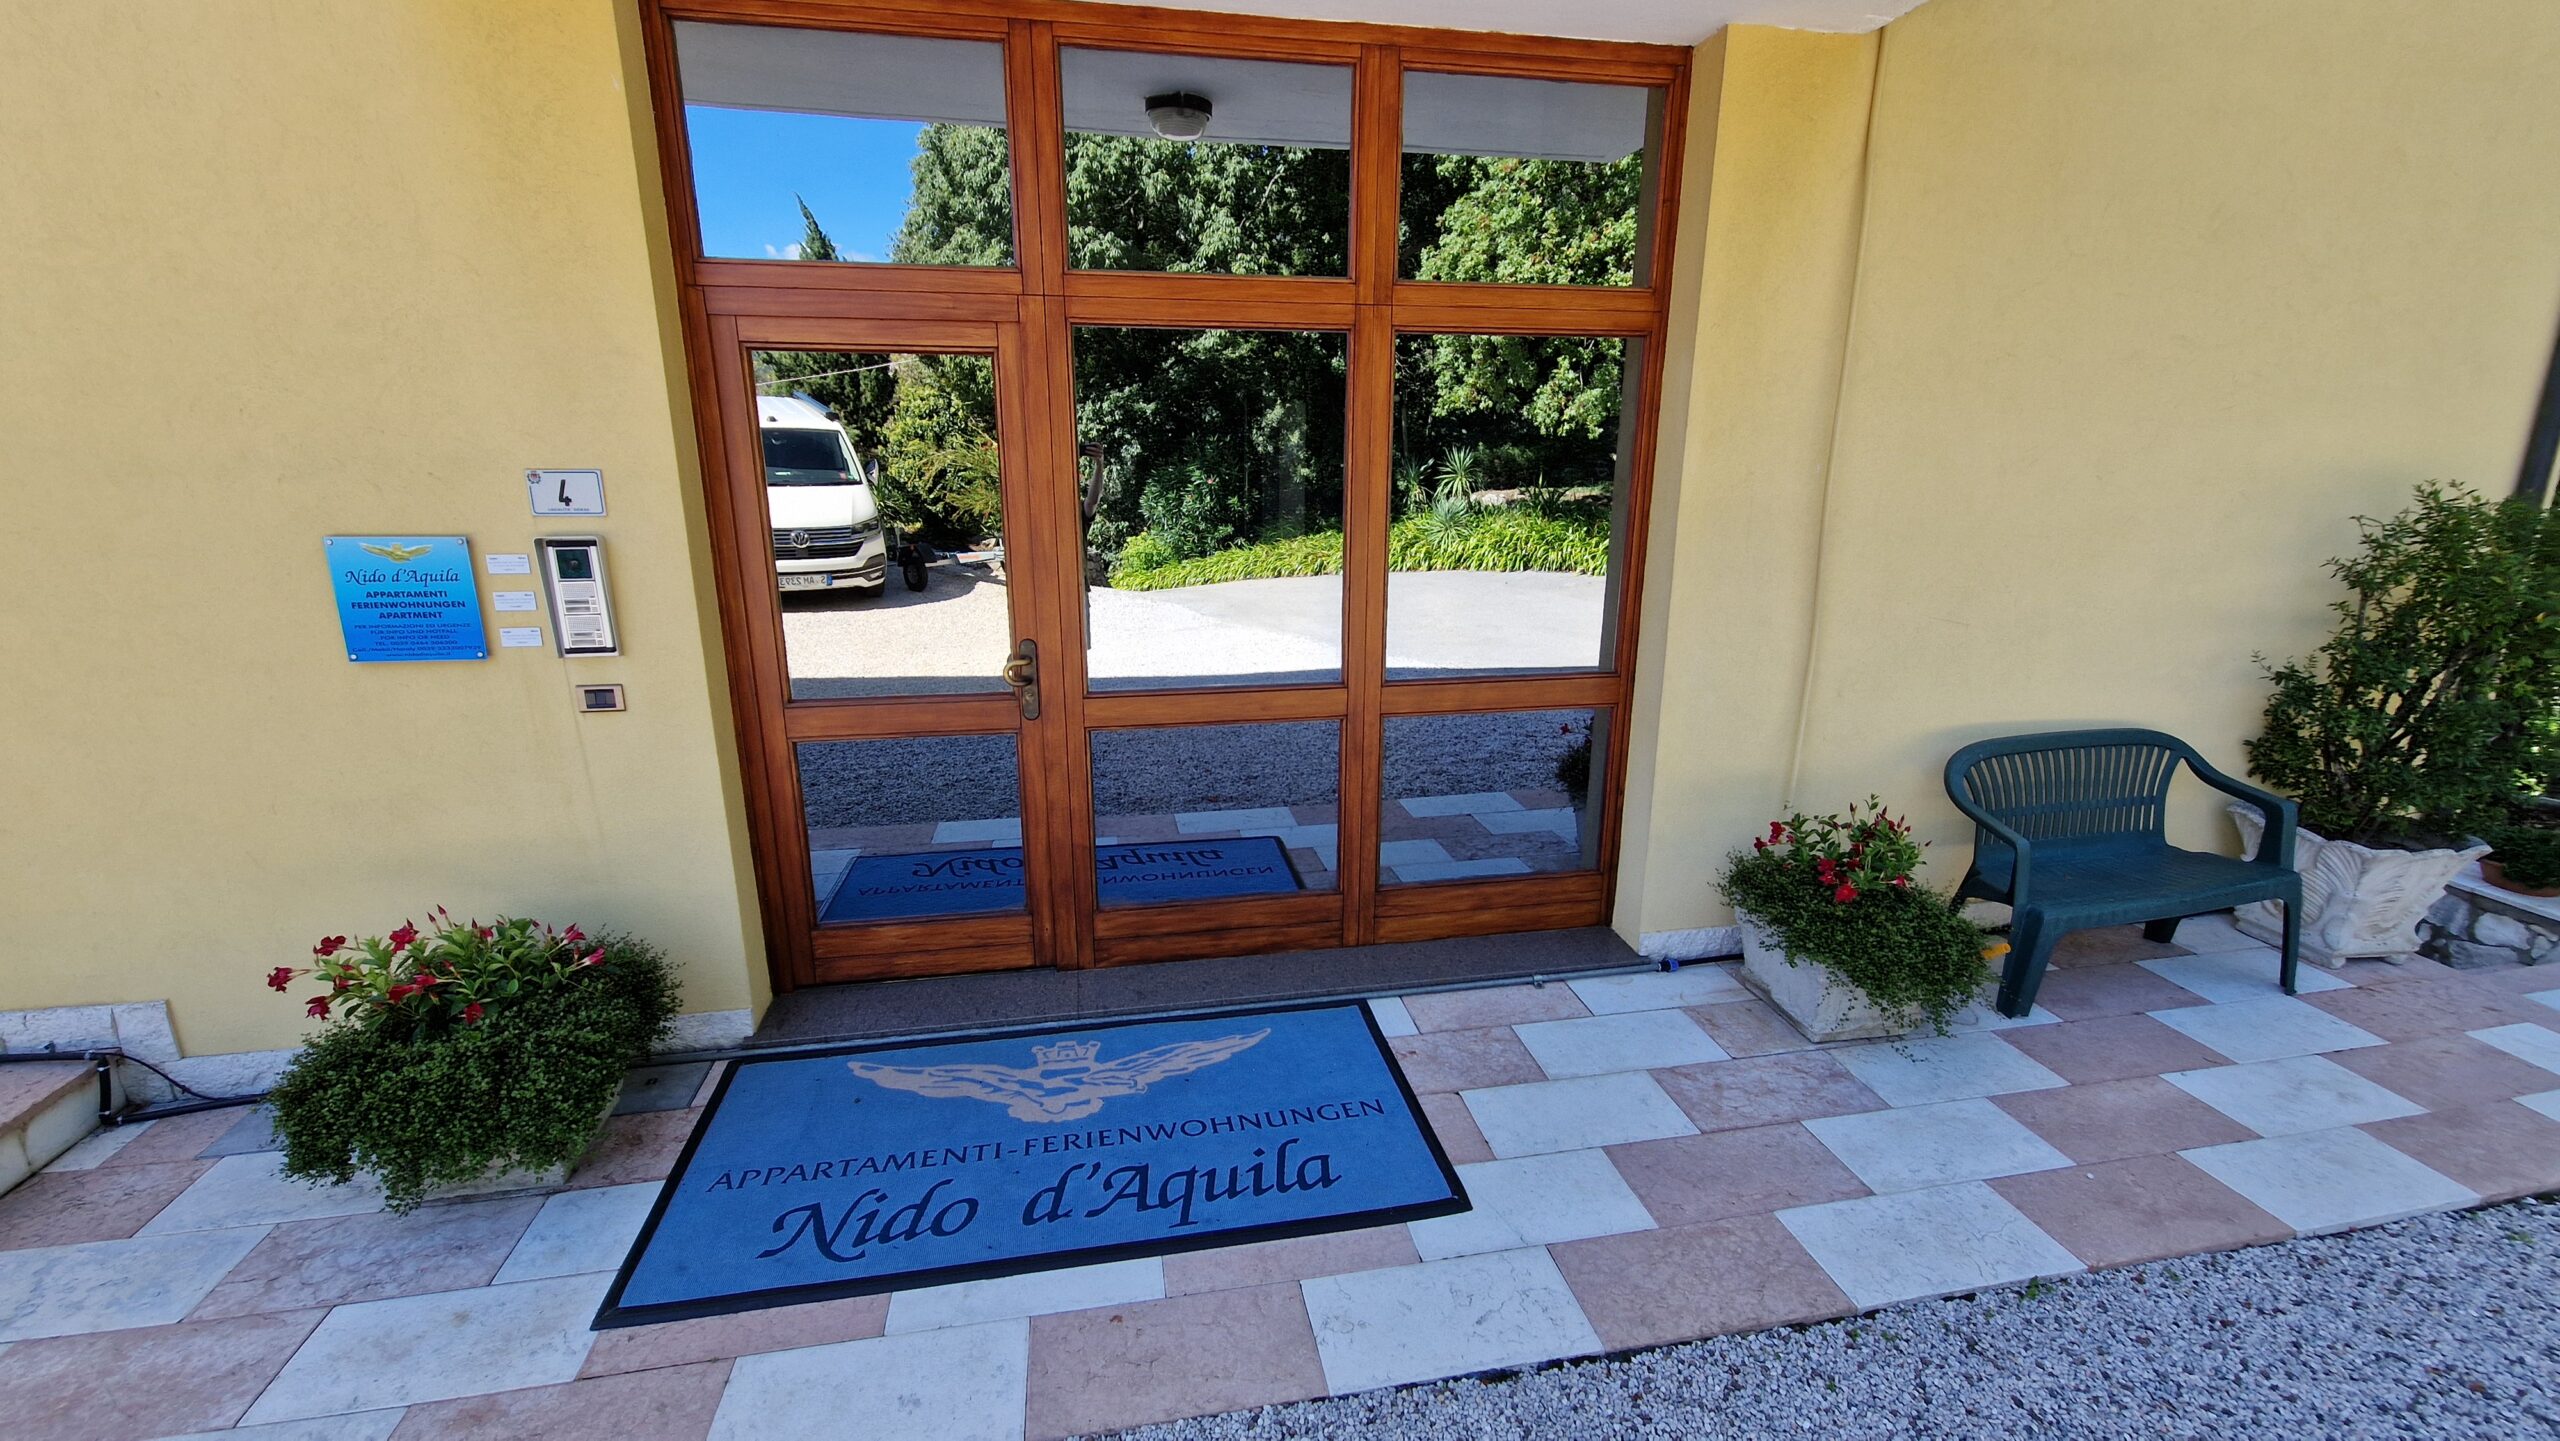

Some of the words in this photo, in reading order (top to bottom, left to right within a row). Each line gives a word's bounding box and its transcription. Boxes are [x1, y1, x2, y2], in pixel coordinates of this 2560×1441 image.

[558, 479, 572, 507] 4
[345, 568, 386, 585] Nido
[391, 568, 460, 587] d'Aquila
[365, 590, 448, 598] APPARTAMENTI
[351, 601, 466, 609] FERIENWOHNUNGEN
[378, 611, 443, 619] APARTMENT
[705, 1098, 1386, 1193] APPARTAMENTI-FERIENWOHNUNGEN
[755, 1178, 979, 1263] Nido
[1021, 1137, 1343, 1229] d'Aquila
